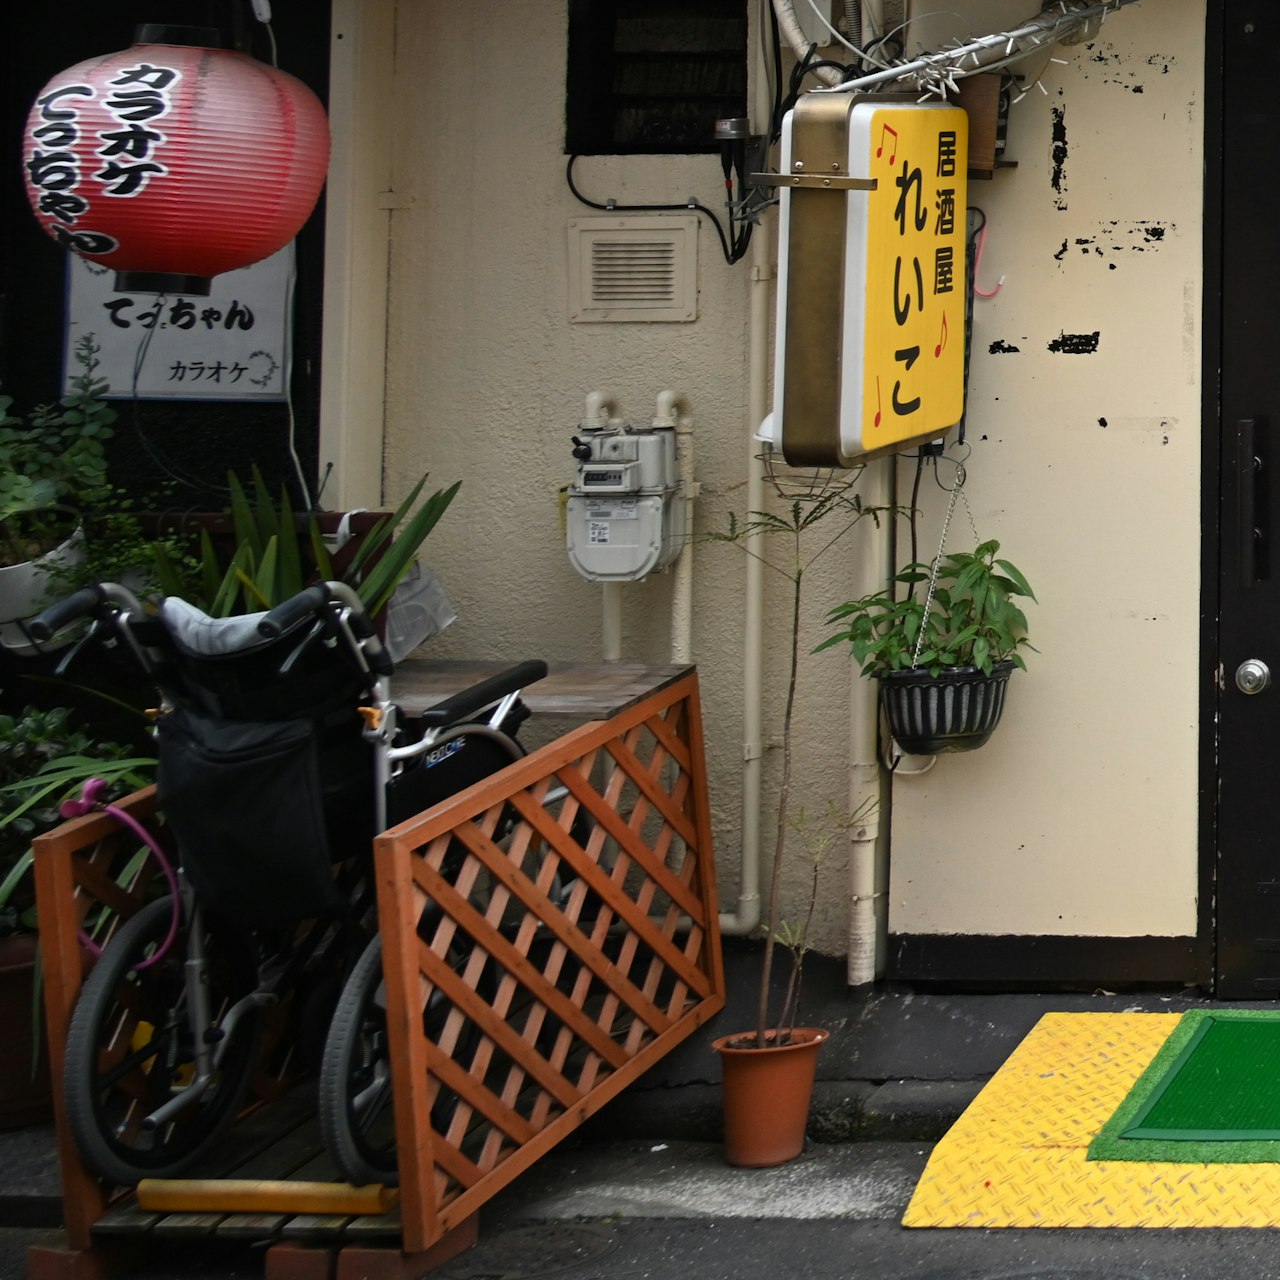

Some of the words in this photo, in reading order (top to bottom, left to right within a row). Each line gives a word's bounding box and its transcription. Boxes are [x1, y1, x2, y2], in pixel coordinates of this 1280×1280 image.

[26, 85, 118, 255] てっちゃん
[95, 65, 181, 197] カラオケ
[933, 131, 957, 296] 居酒屋
[891, 160, 928, 416] れいこ
[168, 361, 249, 383] カラオケ
